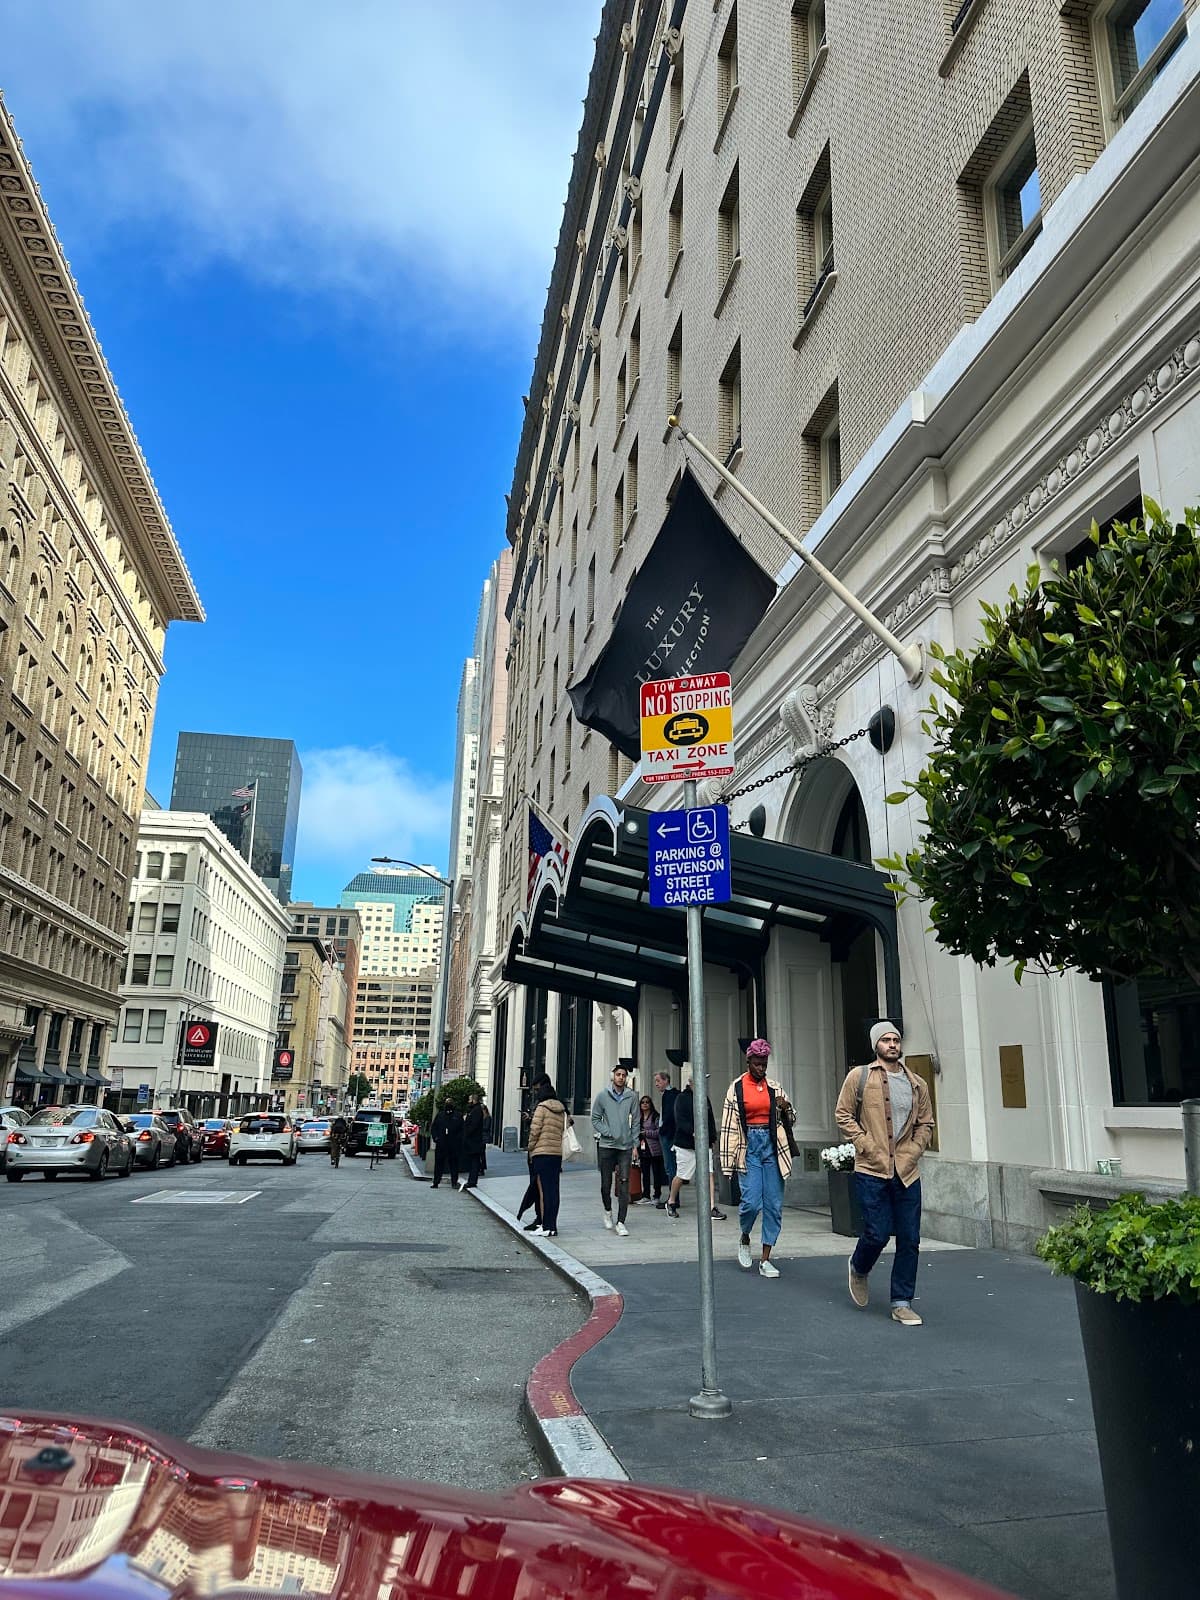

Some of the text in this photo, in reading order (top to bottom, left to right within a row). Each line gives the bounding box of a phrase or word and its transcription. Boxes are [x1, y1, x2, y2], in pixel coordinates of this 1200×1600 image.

[645, 606, 665, 631] THE
[634, 581, 704, 683] LUXURY
[671, 614, 711, 680] LLECTION
[653, 676, 717, 694] TOW AWAY
[645, 690, 731, 716] NO STOPPING
[648, 744, 728, 763] TAXI ZONE
[655, 842, 722, 862] PARKING @
[654, 858, 724, 877] STEVENSON
[666, 874, 711, 890] STREET
[664, 888, 715, 904] GARAGE
